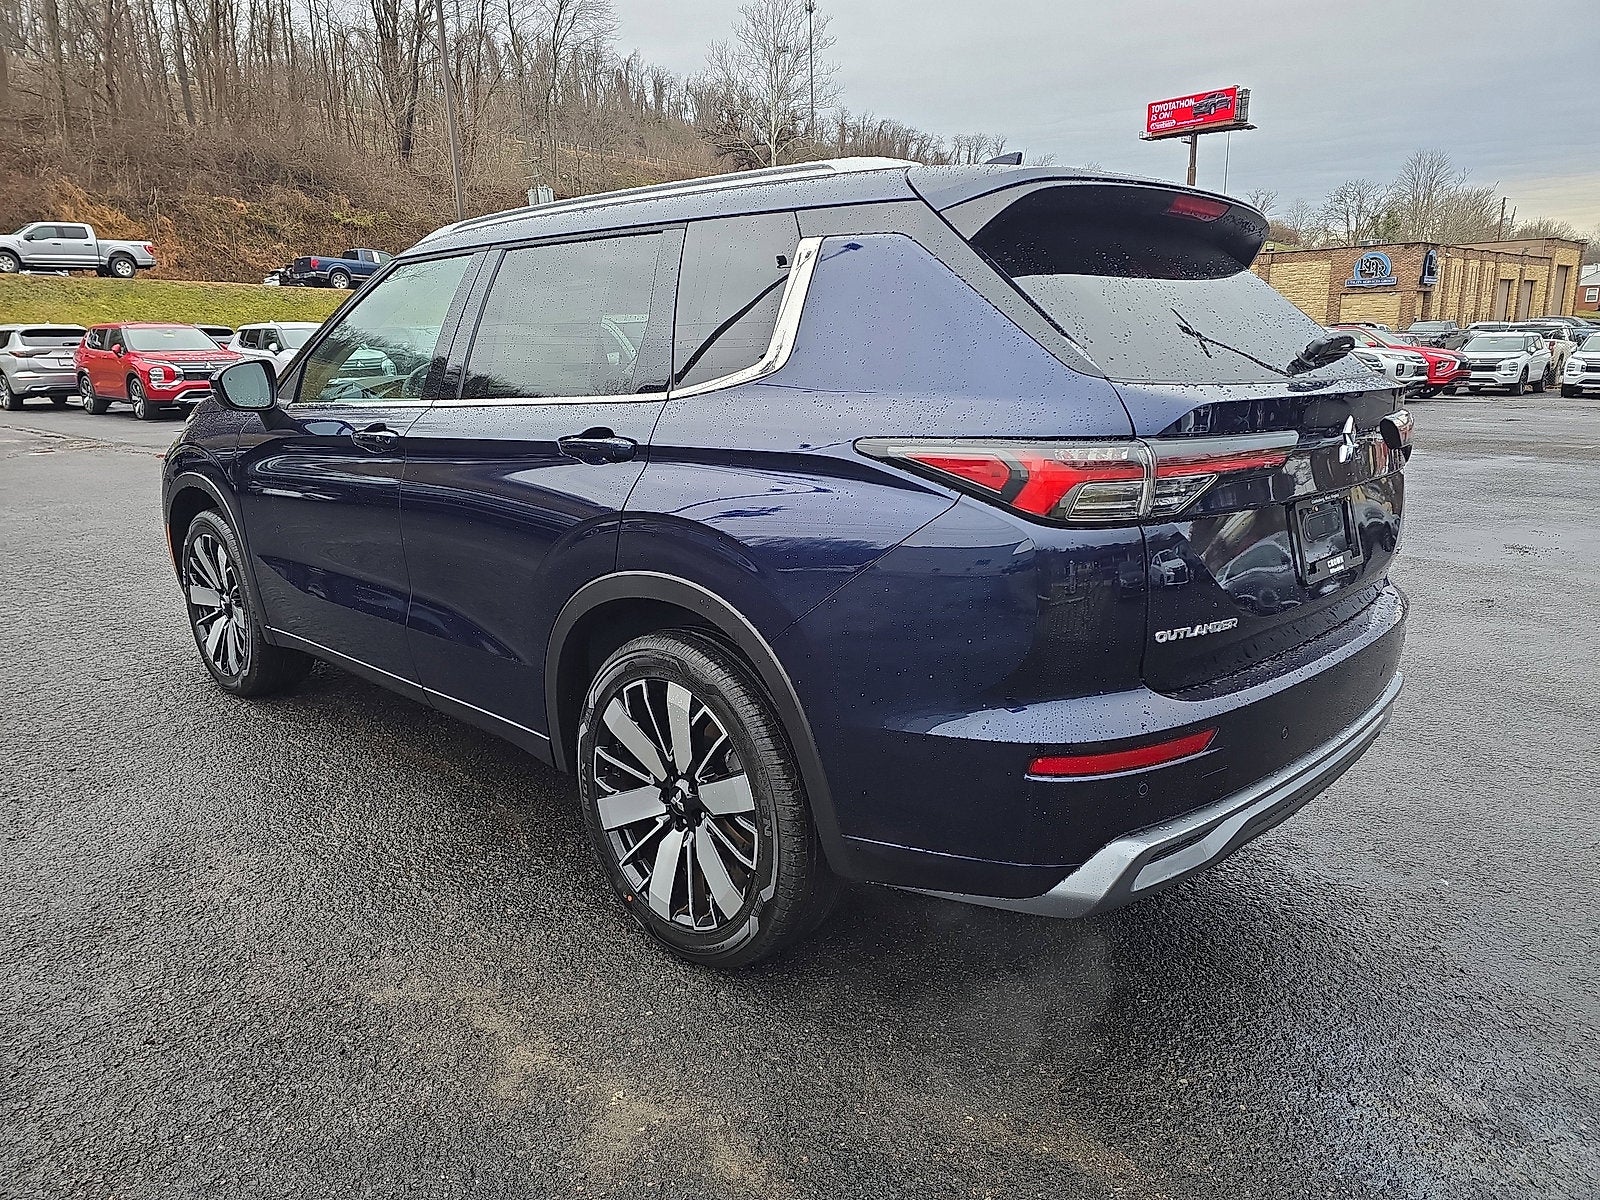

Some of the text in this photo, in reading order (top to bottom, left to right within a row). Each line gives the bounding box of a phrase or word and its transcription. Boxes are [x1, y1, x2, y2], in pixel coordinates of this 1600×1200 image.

[1151, 98, 1195, 114] TOYOTATHON
[1151, 111, 1173, 121] IS ON!
[1155, 617, 1239, 643] OUTLANDER
